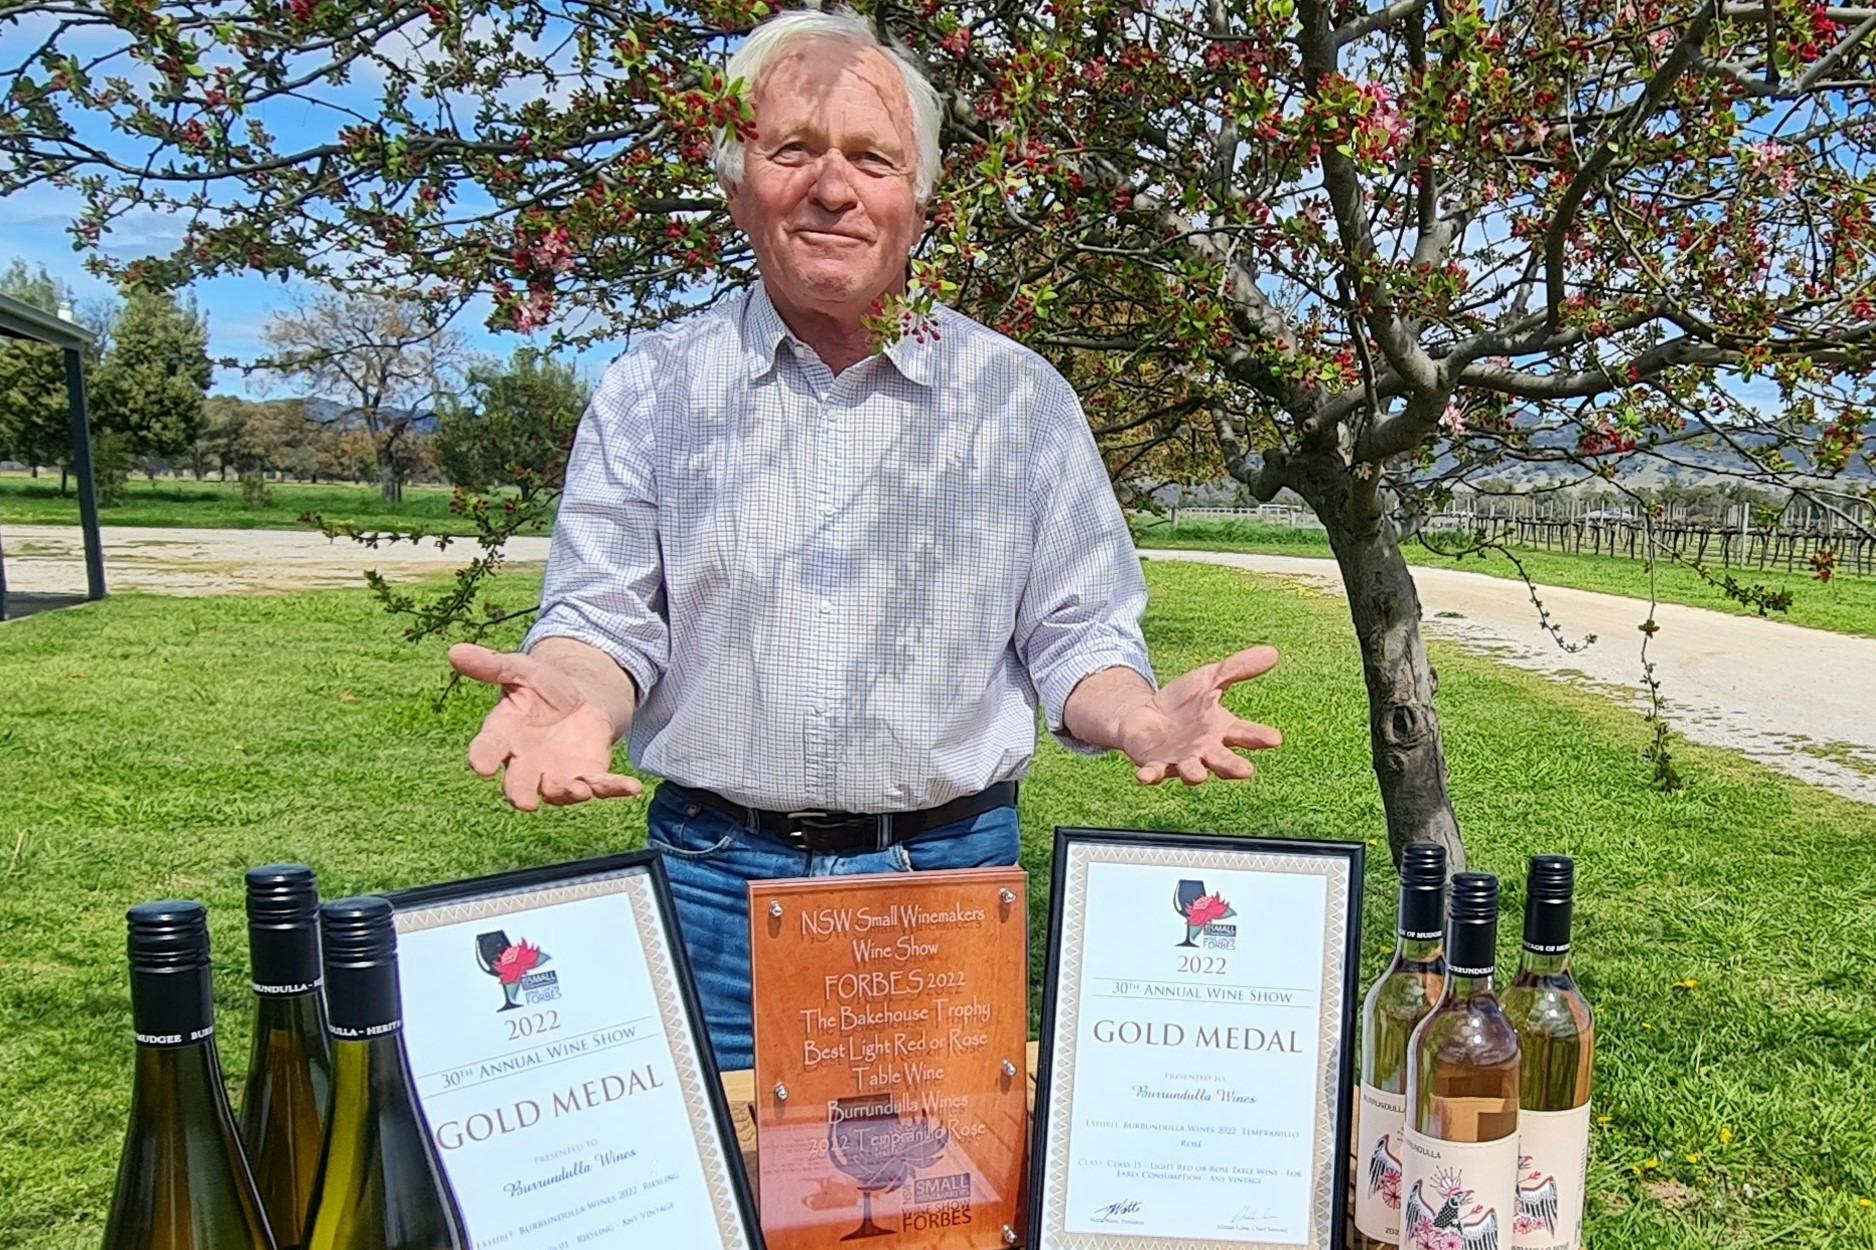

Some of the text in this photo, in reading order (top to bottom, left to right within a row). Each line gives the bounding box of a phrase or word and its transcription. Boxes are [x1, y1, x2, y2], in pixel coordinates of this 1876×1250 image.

[801, 902, 985, 936] NSW Small Winemakers
[853, 936, 939, 964] Wine Show
[1176, 955, 1227, 976] 2022
[825, 969, 967, 1000] FORBES 2022
[1112, 981, 1293, 1004] 30TH ANNUAL WINE SHOW
[504, 1010, 561, 1041] 2022
[801, 996, 991, 1033] The Bakehouse Trophy
[804, 1028, 988, 1065] Best Light Red or Rose
[1093, 1019, 1304, 1054] GOLD MEDAL
[441, 1026, 638, 1089] 30TH ANNUAL WINE SHOW
[852, 1062, 945, 1091] Table Wine
[436, 1064, 664, 1151] GOLD MEDAL
[827, 1089, 969, 1125] Burrundulla Wines
[1132, 1085, 1257, 1105] Burrundulla Wines
[853, 1120, 946, 1152] Tempranillo
[949, 1118, 987, 1140] Rose
[503, 1148, 638, 1198] Burrundulla Wines
[915, 1176, 969, 1194] SMALL
[902, 1208, 973, 1233] FORBES
